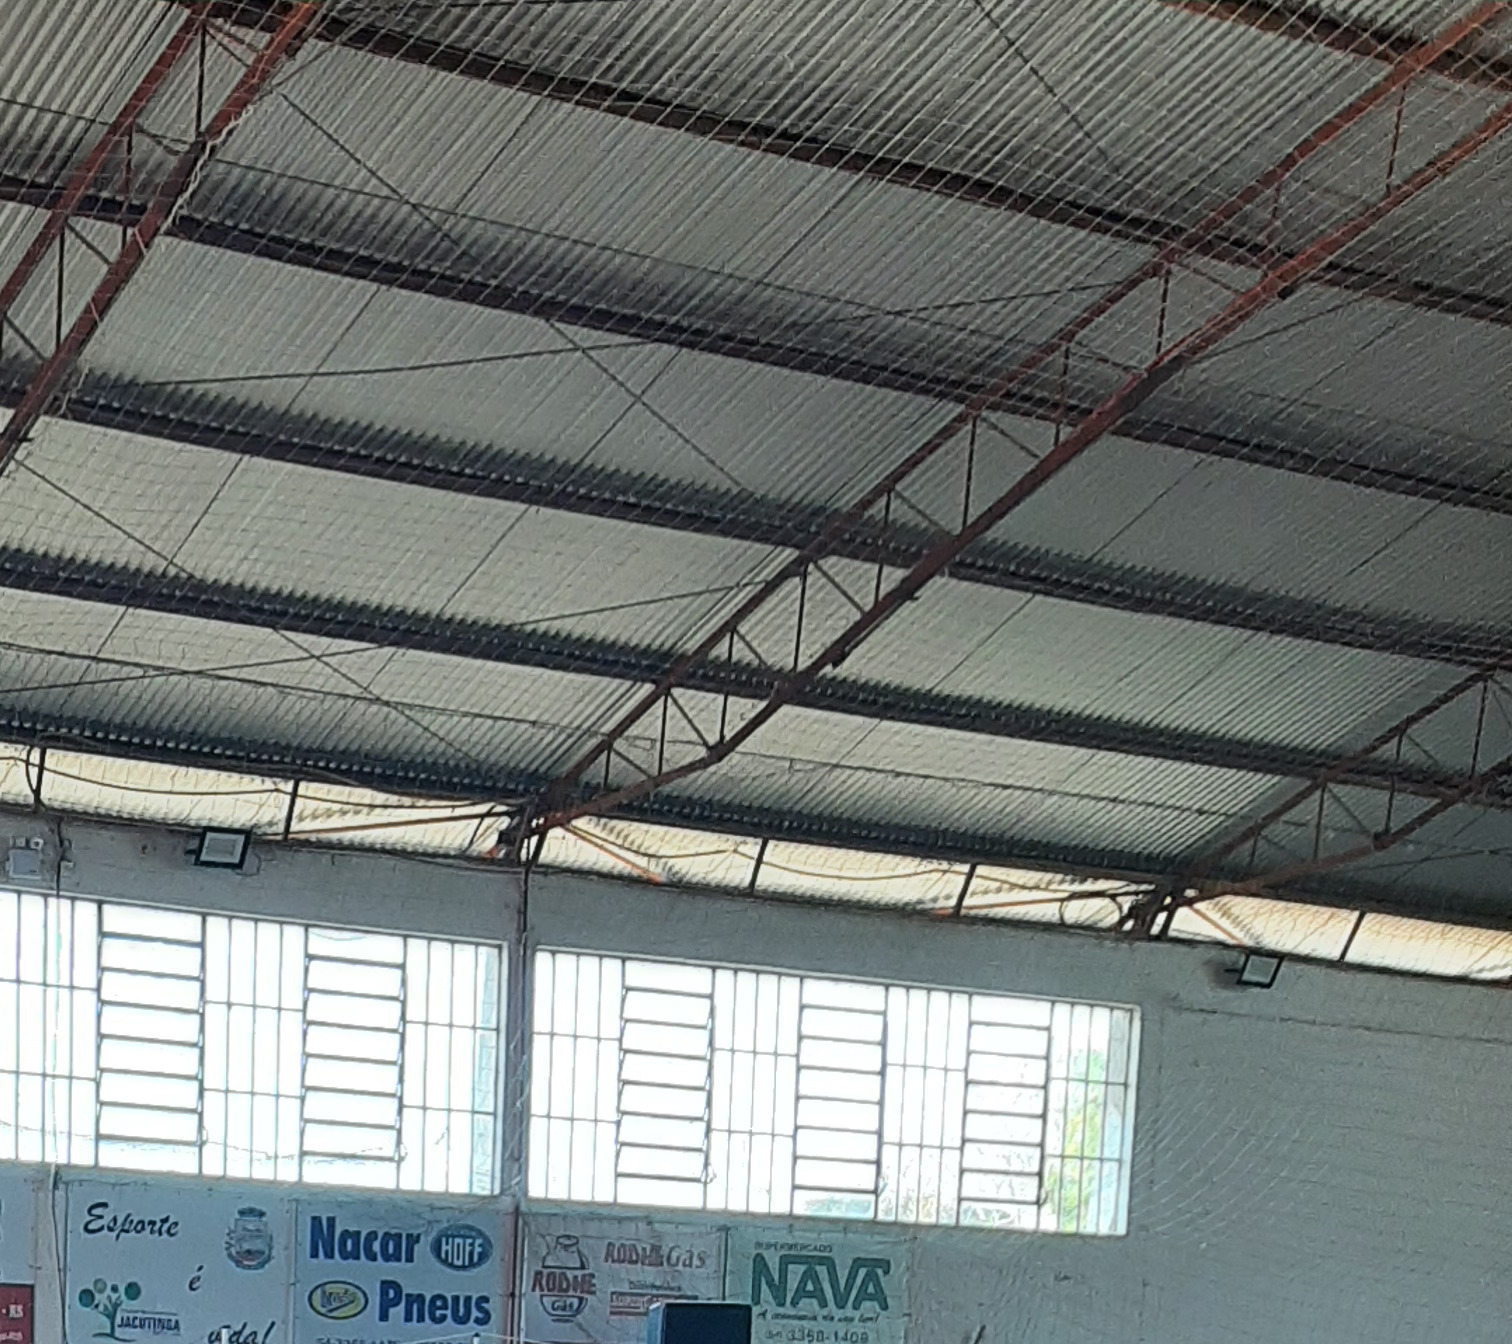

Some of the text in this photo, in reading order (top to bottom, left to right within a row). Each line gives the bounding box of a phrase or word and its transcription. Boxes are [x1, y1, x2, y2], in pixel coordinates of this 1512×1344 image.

[83, 1202, 180, 1241] Esporte
[308, 1215, 422, 1264] Nacar
[440, 1236, 485, 1267] HOFF
[187, 1264, 205, 1292] é
[751, 1252, 892, 1311] NAVA
[377, 1279, 493, 1327] Pneus
